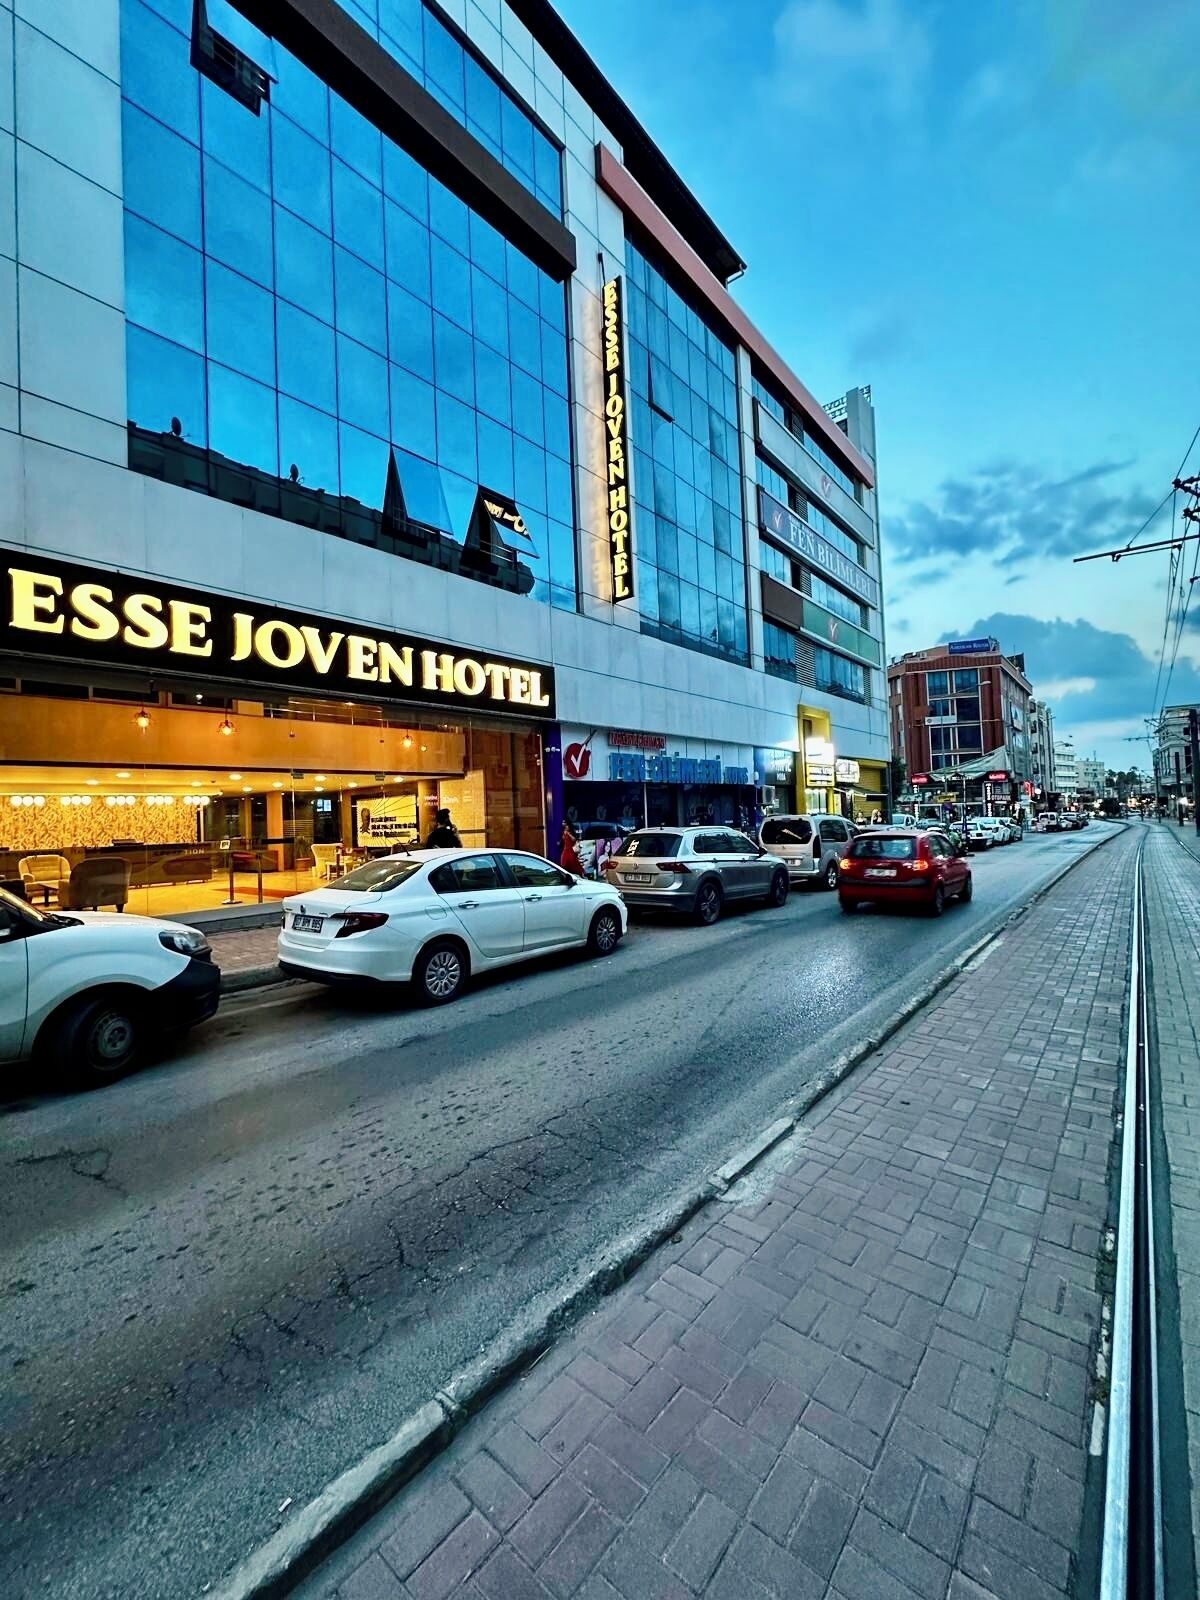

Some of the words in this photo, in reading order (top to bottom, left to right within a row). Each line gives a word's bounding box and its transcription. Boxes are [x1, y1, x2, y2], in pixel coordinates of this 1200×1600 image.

[603, 280, 619, 372] ESSE
[605, 373, 626, 485] JOVEN
[608, 489, 630, 599] HOTEL
[790, 523, 815, 557] FEN
[8, 567, 213, 658] ESSE
[230, 612, 414, 687] JOVEN
[420, 650, 550, 708] HOTEL
[608, 752, 646, 782] FEN
